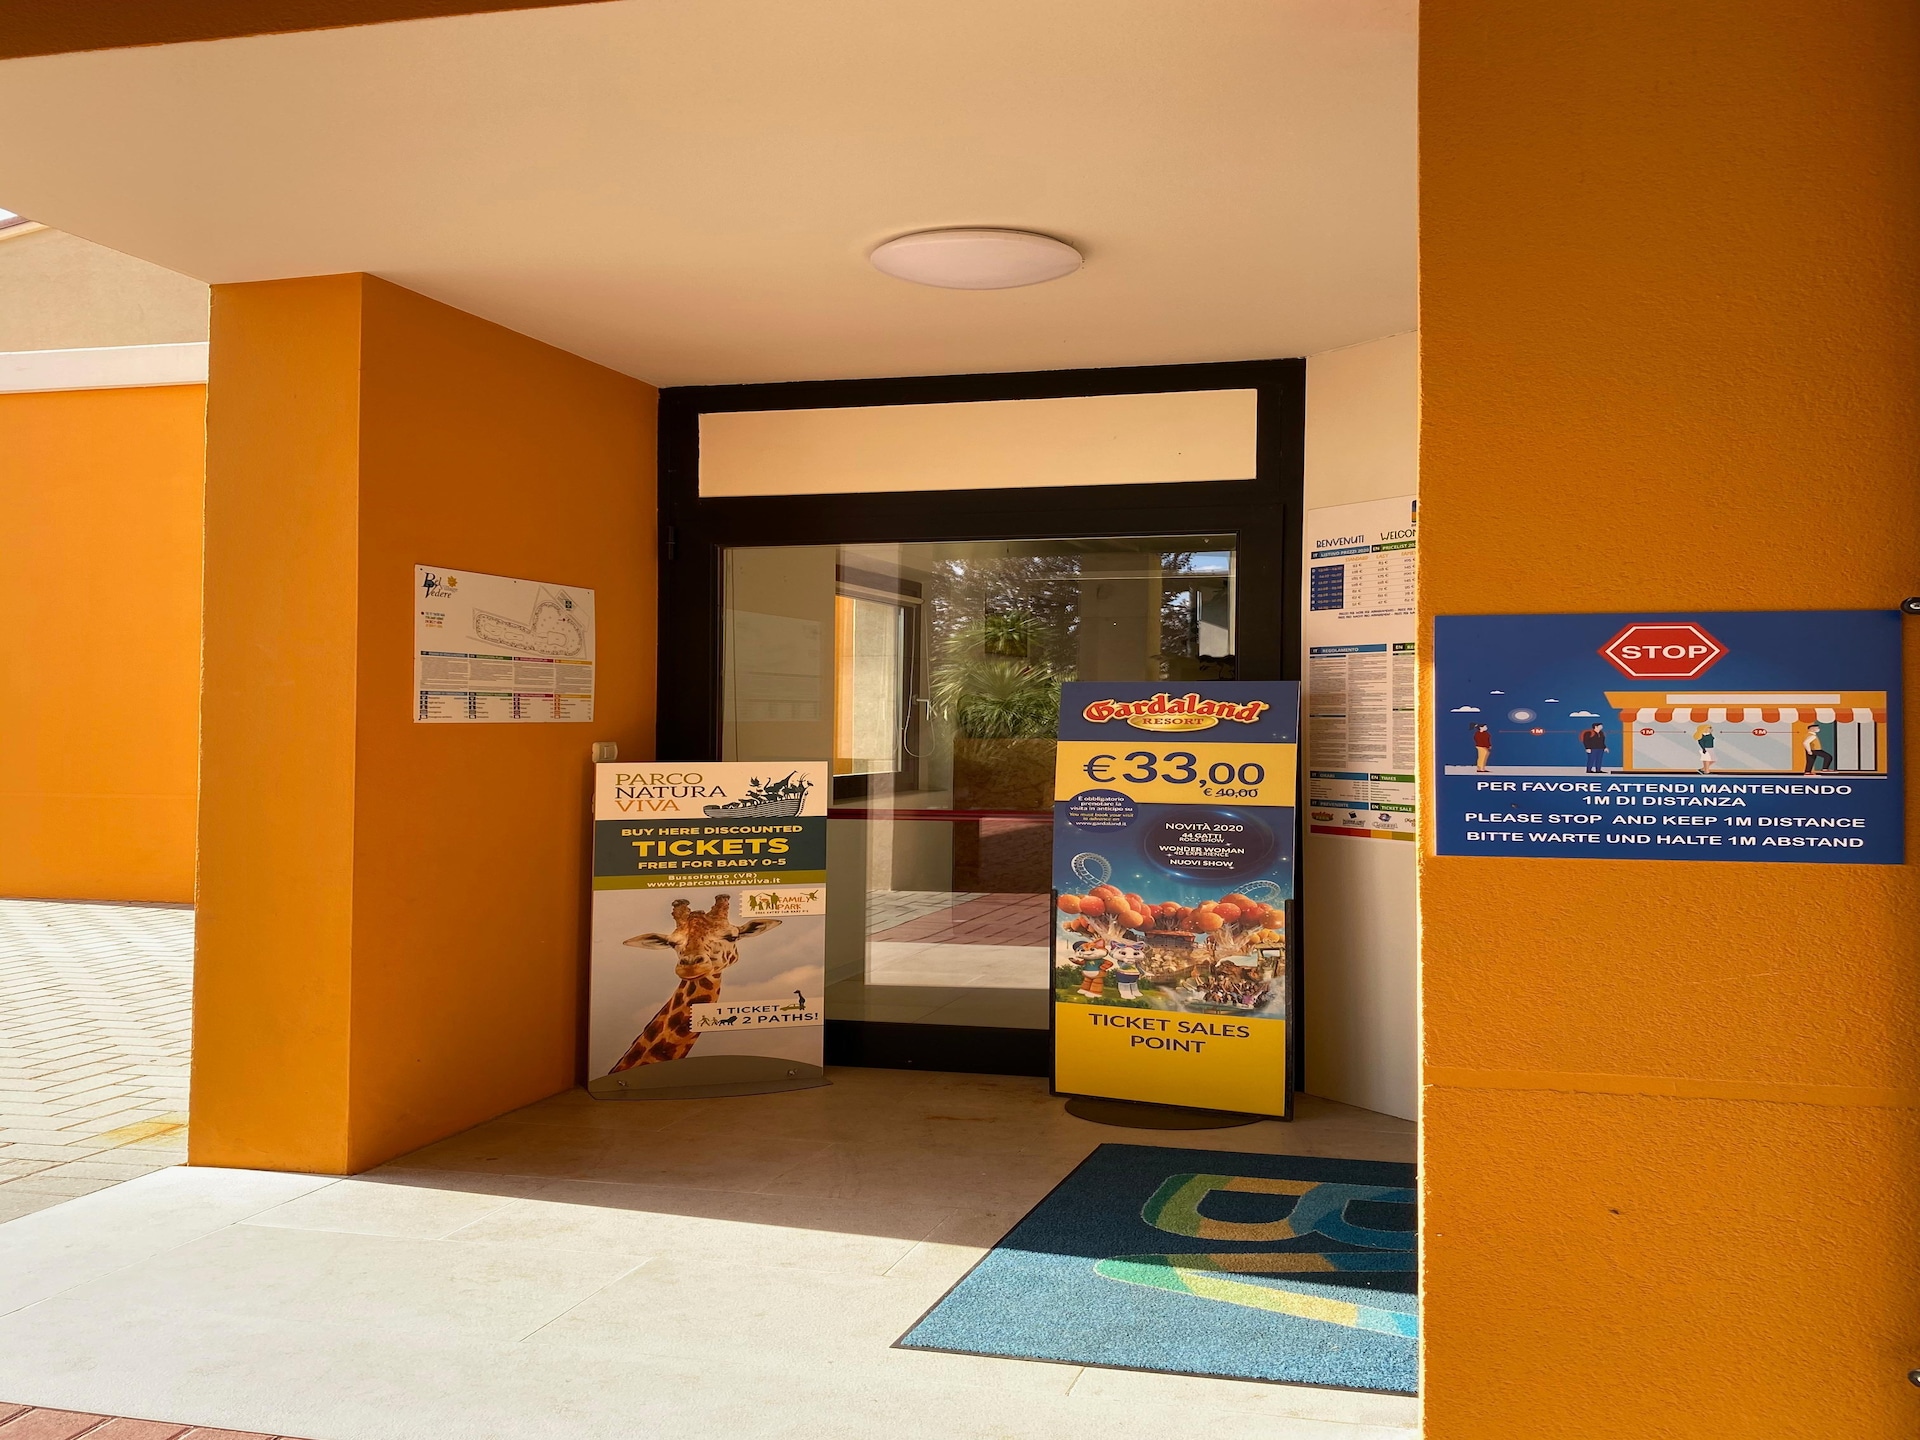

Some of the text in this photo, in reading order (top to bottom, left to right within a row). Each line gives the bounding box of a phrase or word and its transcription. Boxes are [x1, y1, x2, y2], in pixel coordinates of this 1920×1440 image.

[1316, 535, 1365, 548] BENVENUTI
[1621, 645, 1708, 660] STOP
[1085, 694, 1269, 722] Gardaland
[1142, 718, 1204, 726] RESORT
[615, 773, 703, 786] PARCO
[615, 786, 727, 798] NATURA
[1204, 788, 1258, 798] € 40,00
[1477, 781, 1852, 795] PER FAVORE ATTENDI MANTENENDO
[615, 800, 680, 812] VIVA
[1582, 796, 1746, 807] 1M DI DISTANZA
[1166, 822, 1211, 831] NOVITÀ
[1466, 813, 1866, 828] PLEASE STOP AND KEEP 1M DISTANCE
[621, 825, 803, 836] BUY HERE DISCOUNTED
[1467, 832, 1864, 848] BITTE WARTE UND HALTE 1M ABSTAND
[632, 838, 789, 857] TICKETS
[638, 861, 677, 870] FREE
[681, 860, 712, 868] FOR
[717, 859, 758, 867] BABY
[647, 878, 781, 888] www.parconaturaviva.it
[668, 873, 730, 882] Bussolengo
[726, 1005, 780, 1014] TICKET
[742, 1012, 818, 1024] 2 PATHS!
[1088, 1014, 1250, 1038] TICKET SALES
[1131, 1036, 1206, 1053] POINT
